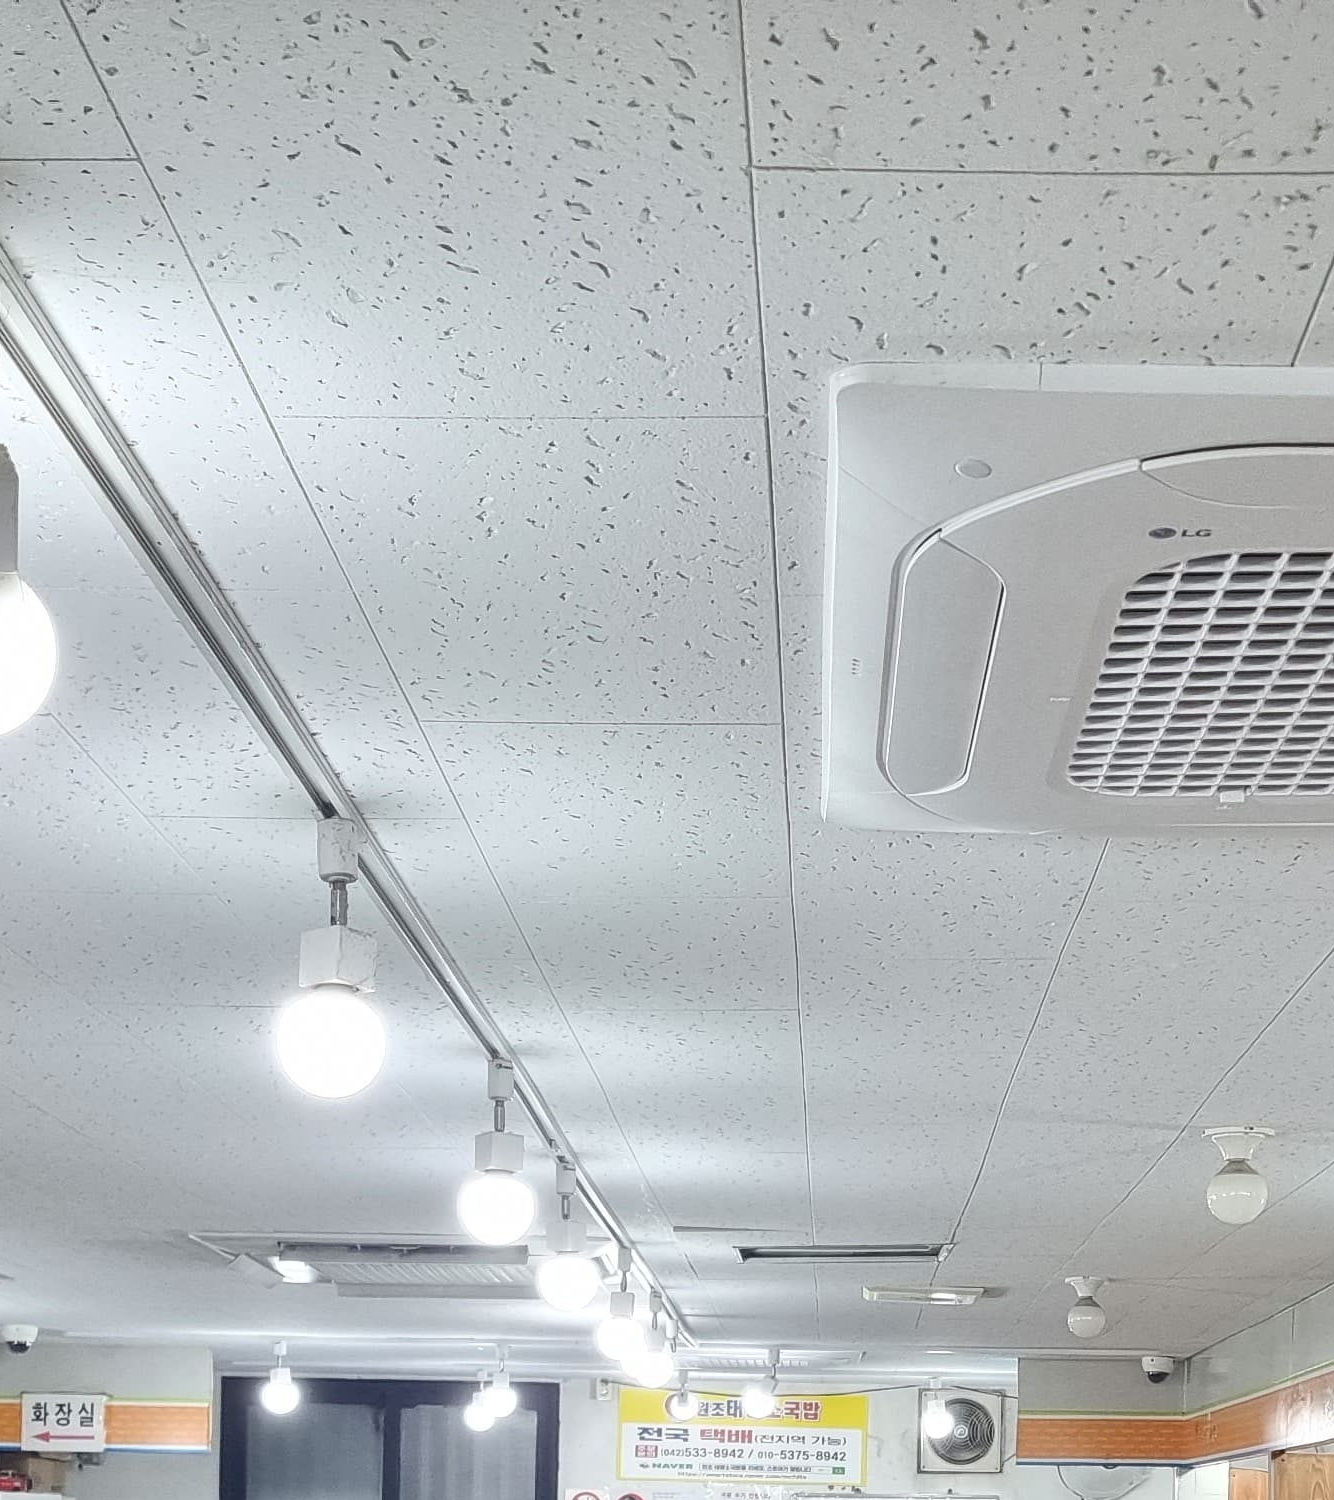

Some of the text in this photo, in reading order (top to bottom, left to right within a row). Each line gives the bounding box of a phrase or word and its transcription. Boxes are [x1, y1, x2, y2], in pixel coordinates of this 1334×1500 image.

[1180, 528, 1212, 538] LG
[31, 1401, 96, 1428] 화장실
[637, 1426, 690, 1443] 전국
[700, 1428, 753, 1444] 택배
[660, 1447, 745, 1459] (042)533-8942
[757, 1449, 847, 1462] 010-5375-8942
[652, 1462, 693, 1470] NAVER
